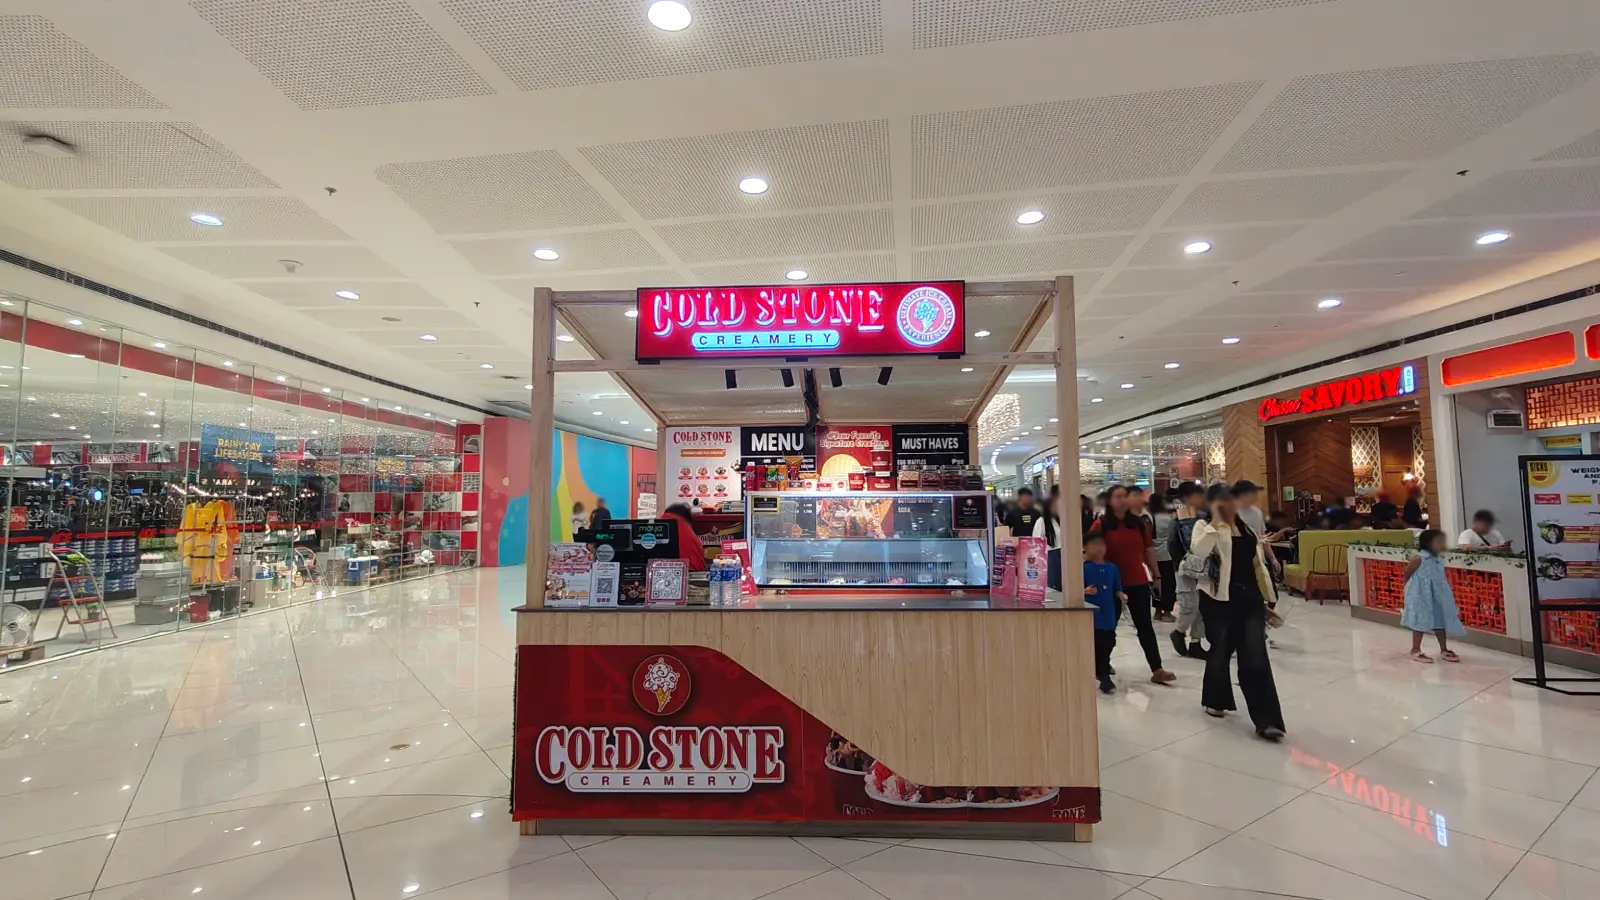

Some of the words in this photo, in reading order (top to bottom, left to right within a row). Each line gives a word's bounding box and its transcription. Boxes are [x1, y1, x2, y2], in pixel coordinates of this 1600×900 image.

[652, 287, 746, 337] COLD
[753, 285, 885, 332] STONE
[699, 332, 832, 346] CREAMERY
[1300, 367, 1402, 414] SAVORY
[673, 431, 699, 445] COLD
[700, 431, 732, 444] STONE
[751, 432, 805, 452] MENU
[820, 439, 855, 450] Signature
[901, 437, 928, 450] MUST
[929, 437, 959, 450] HAVES
[91, 453, 136, 462] HARDWARE
[215, 447, 263, 463] LIFESAVERS
[536, 727, 643, 783] COLD
[648, 727, 784, 783] STONE
[580, 775, 738, 786] CREAMERY
